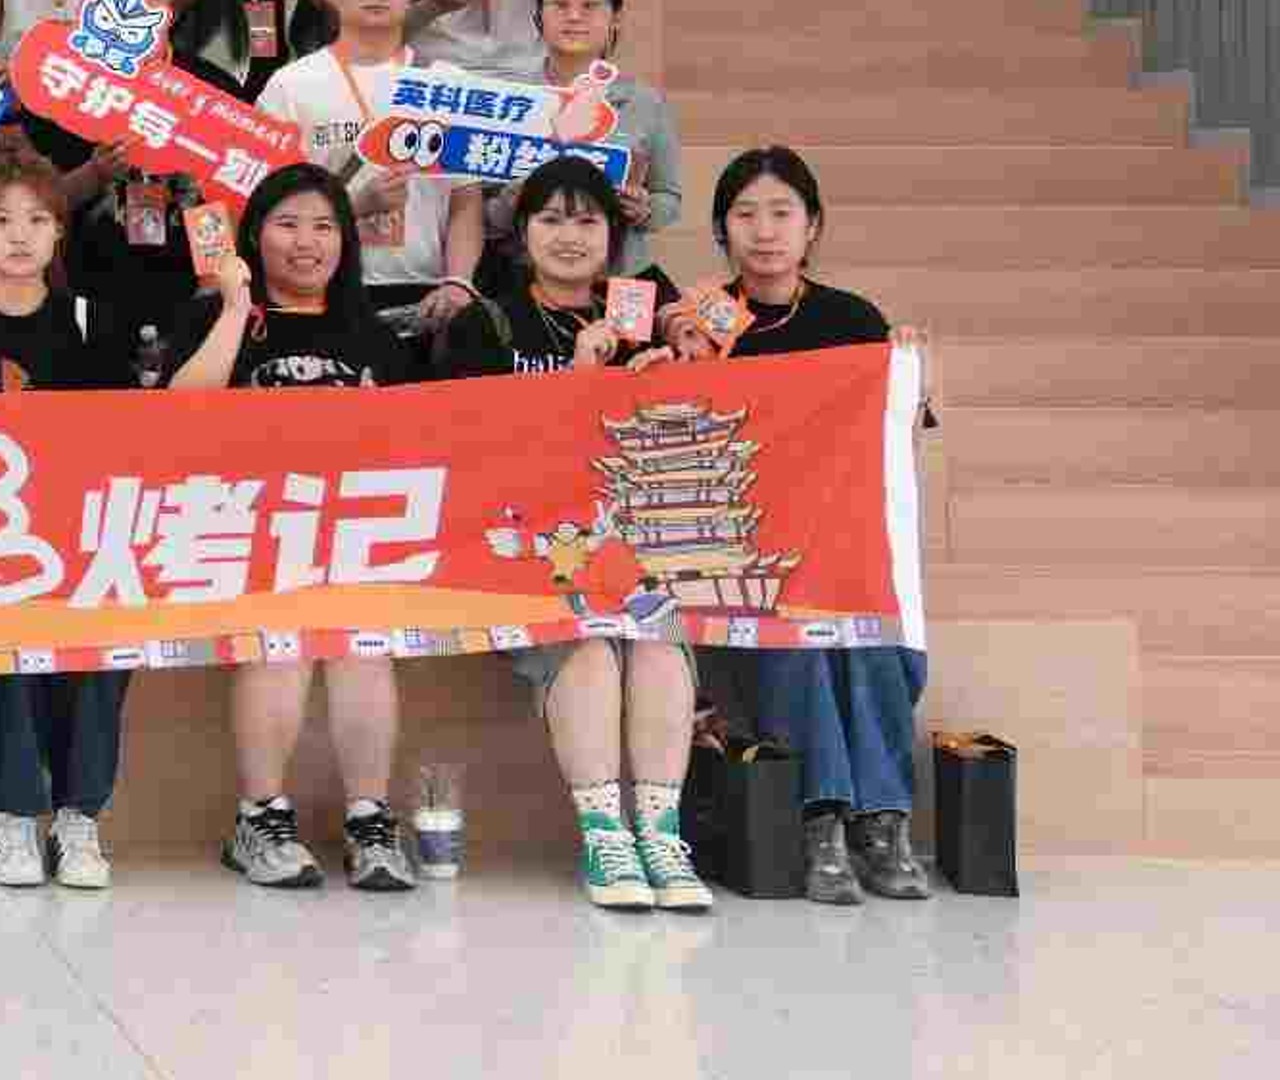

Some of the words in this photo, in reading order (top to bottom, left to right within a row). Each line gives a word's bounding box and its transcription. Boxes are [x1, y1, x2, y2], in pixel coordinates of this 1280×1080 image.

[40, 55, 270, 199] 守护每一刻
[392, 78, 537, 122] 英科医疗
